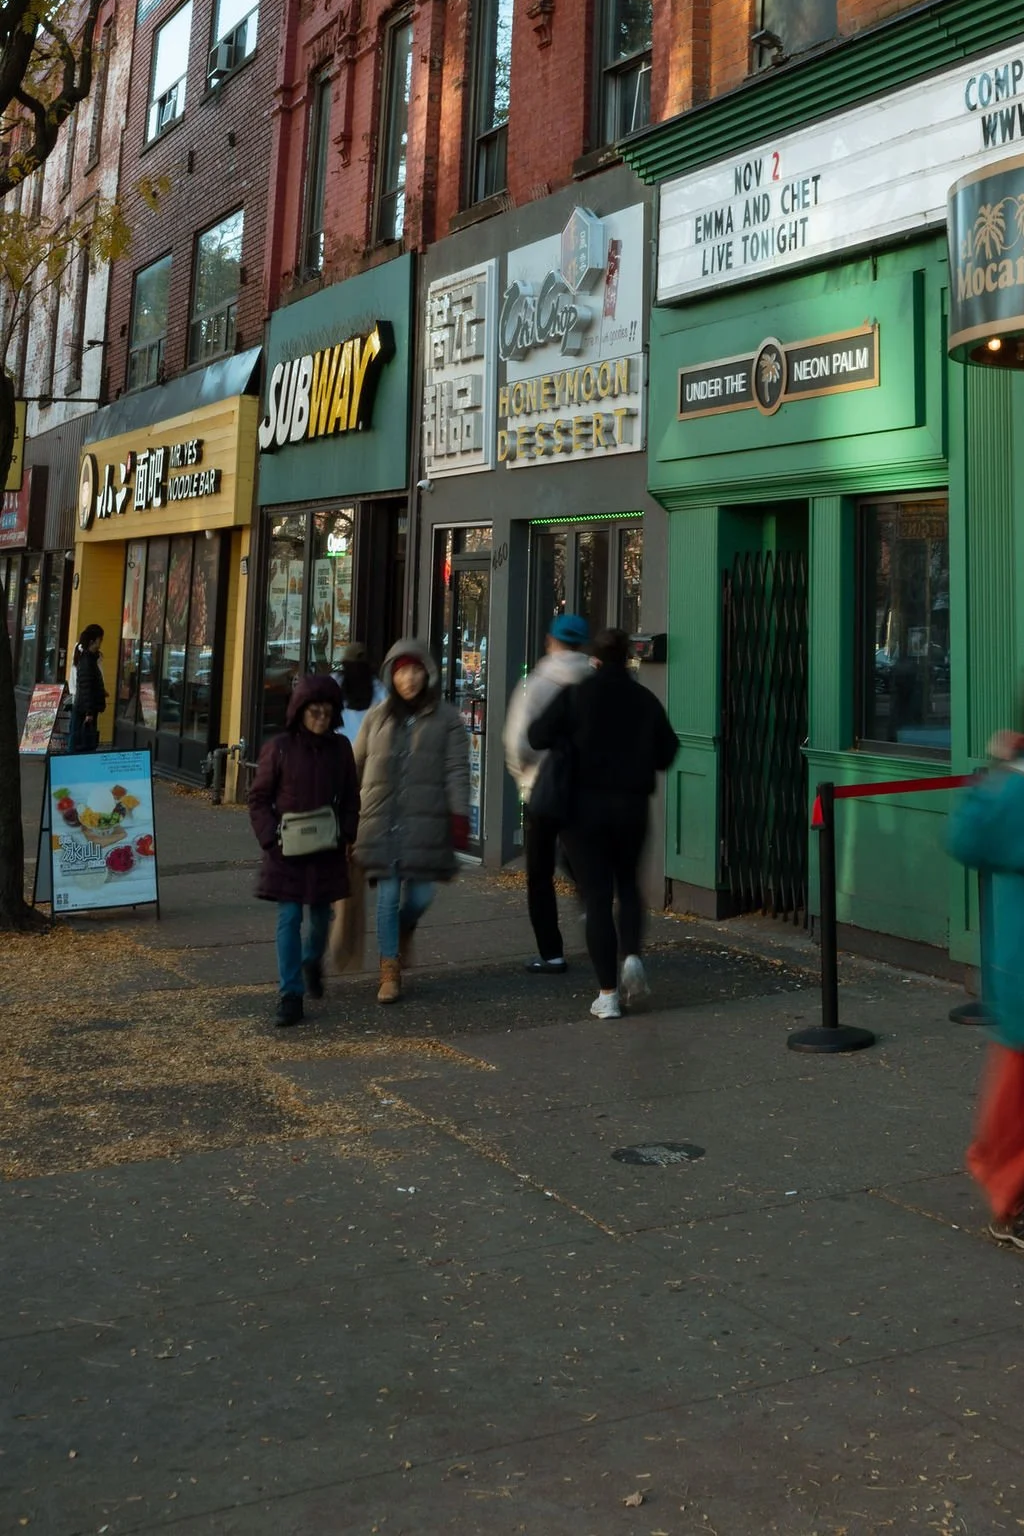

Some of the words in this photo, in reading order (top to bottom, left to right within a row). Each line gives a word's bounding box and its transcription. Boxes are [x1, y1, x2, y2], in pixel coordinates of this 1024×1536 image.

[734, 158, 763, 195] NOV
[772, 151, 781, 181] 2
[695, 205, 733, 244] EMMA
[743, 193, 771, 229] AND
[781, 174, 821, 214] CHET
[702, 241, 733, 276] LIVE
[741, 217, 808, 264] TONIGHT
[258, 323, 383, 450] SUBWAY
[499, 357, 632, 417] HONEYMOON
[685, 377, 723, 402] UNDER
[724, 372, 747, 394] THE
[793, 355, 830, 382] NEON
[832, 347, 870, 374] PALM
[183, 439, 198, 465] YES
[498, 408, 632, 461] DESSERT
[167, 474, 198, 501] NOODLE
[198, 469, 216, 496] BAR
